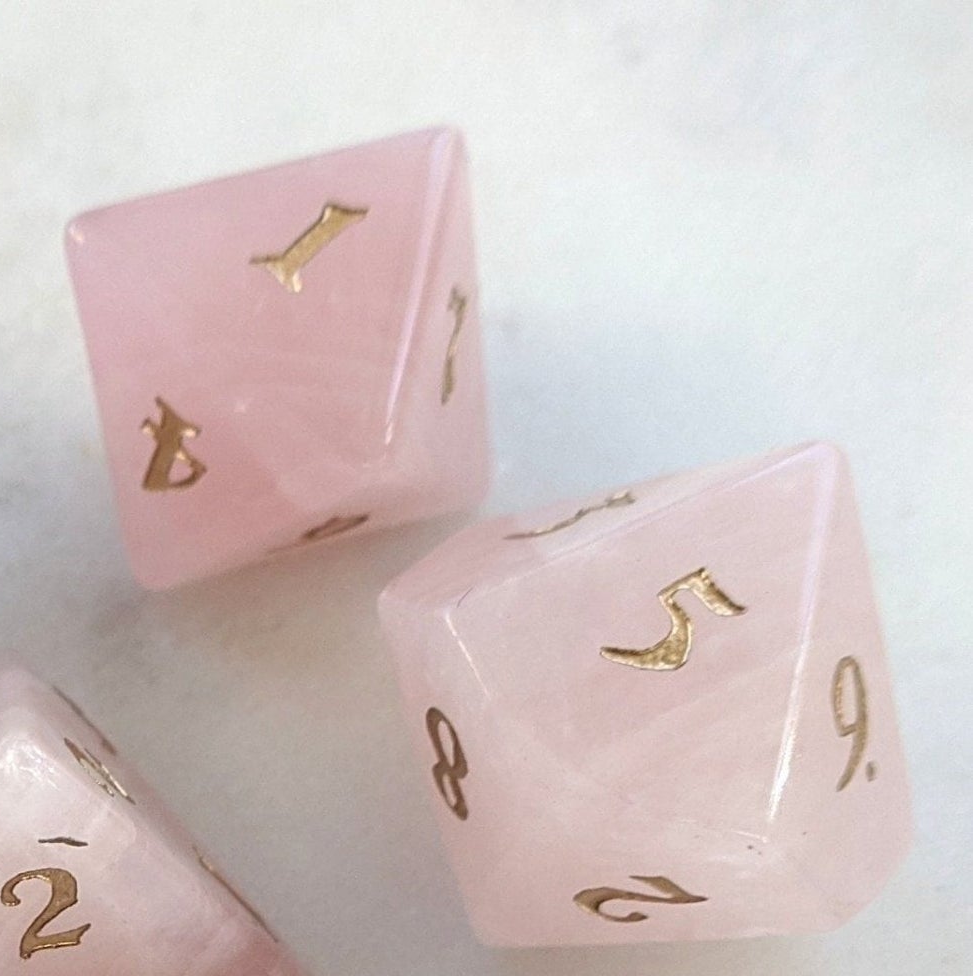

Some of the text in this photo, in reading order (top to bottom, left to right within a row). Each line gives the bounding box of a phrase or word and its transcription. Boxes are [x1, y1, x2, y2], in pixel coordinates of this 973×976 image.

[249, 202, 368, 292] 1
[141, 397, 207, 492] 4
[600, 567, 747, 671] 5
[426, 707, 469, 821] 8
[0, 867, 91, 959] 2
[573, 875, 708, 922] 2
